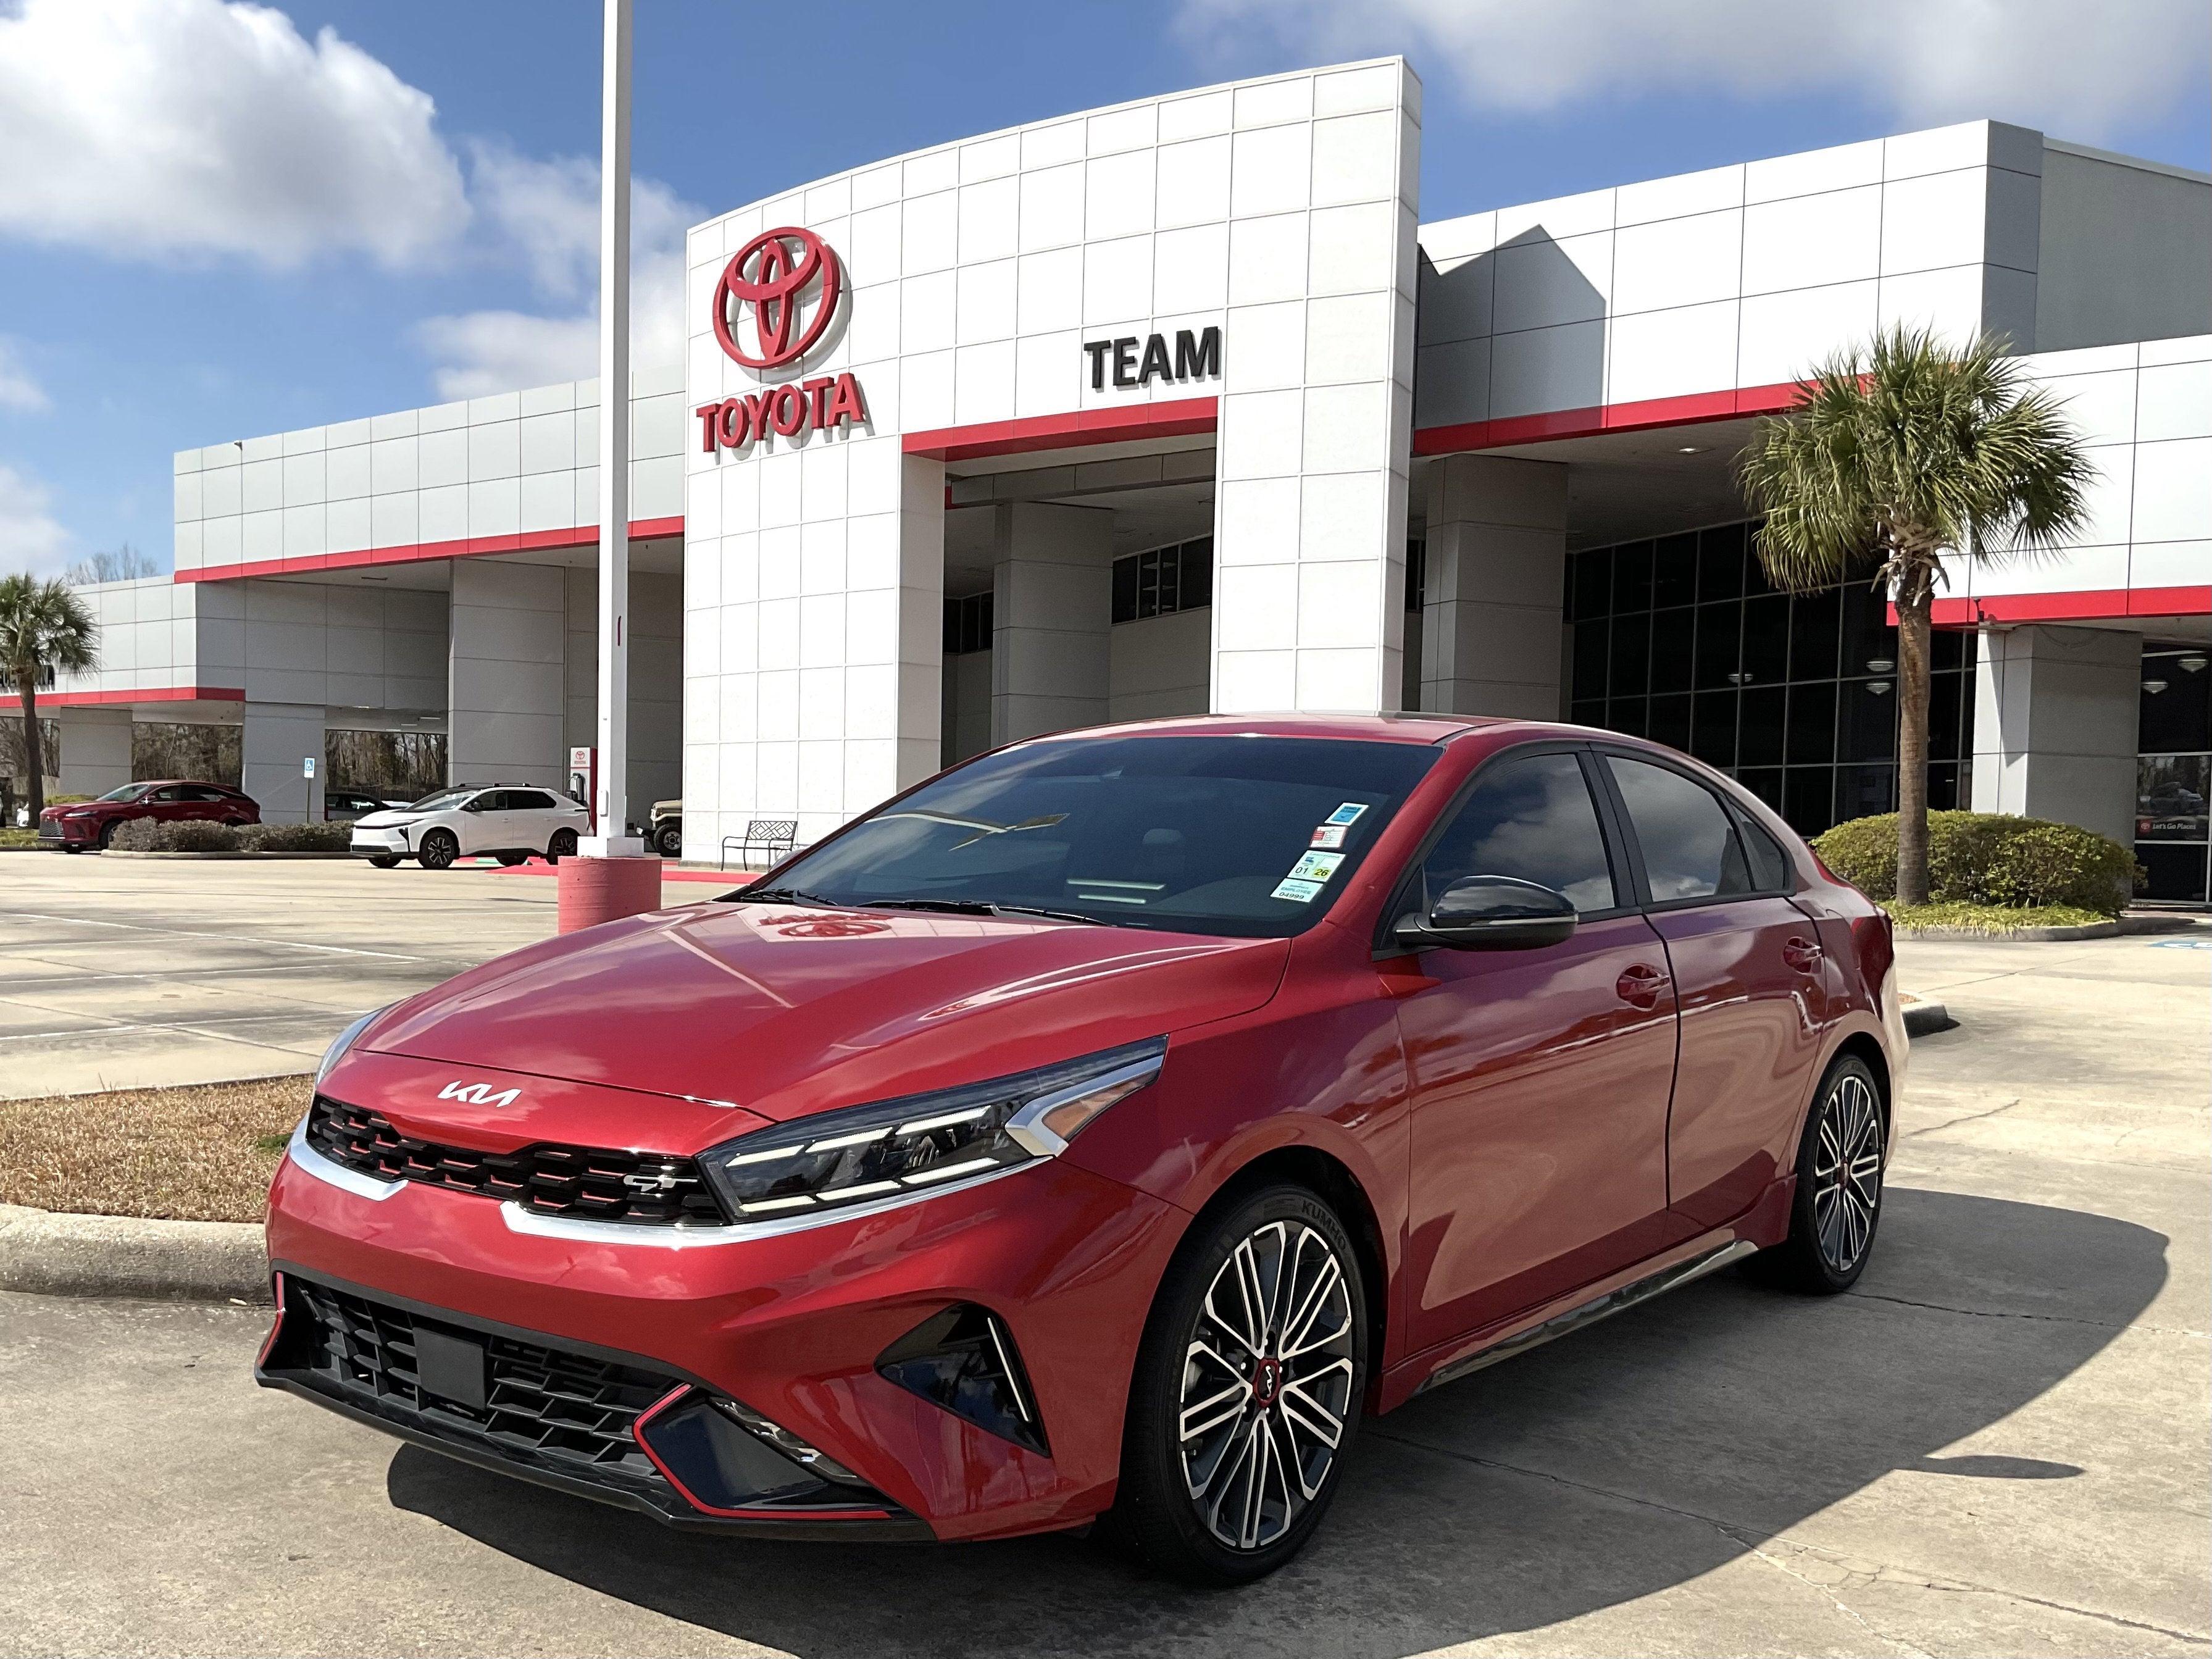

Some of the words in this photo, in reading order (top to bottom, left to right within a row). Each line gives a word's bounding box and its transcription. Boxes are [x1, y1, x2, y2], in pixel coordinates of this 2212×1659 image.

[1083, 326, 1219, 388] TEAM
[696, 372, 866, 453] TOYOTA
[1314, 869, 1329, 877] 26
[437, 1080, 522, 1108] KIA
[1301, 1200, 1346, 1250] KUMHO
